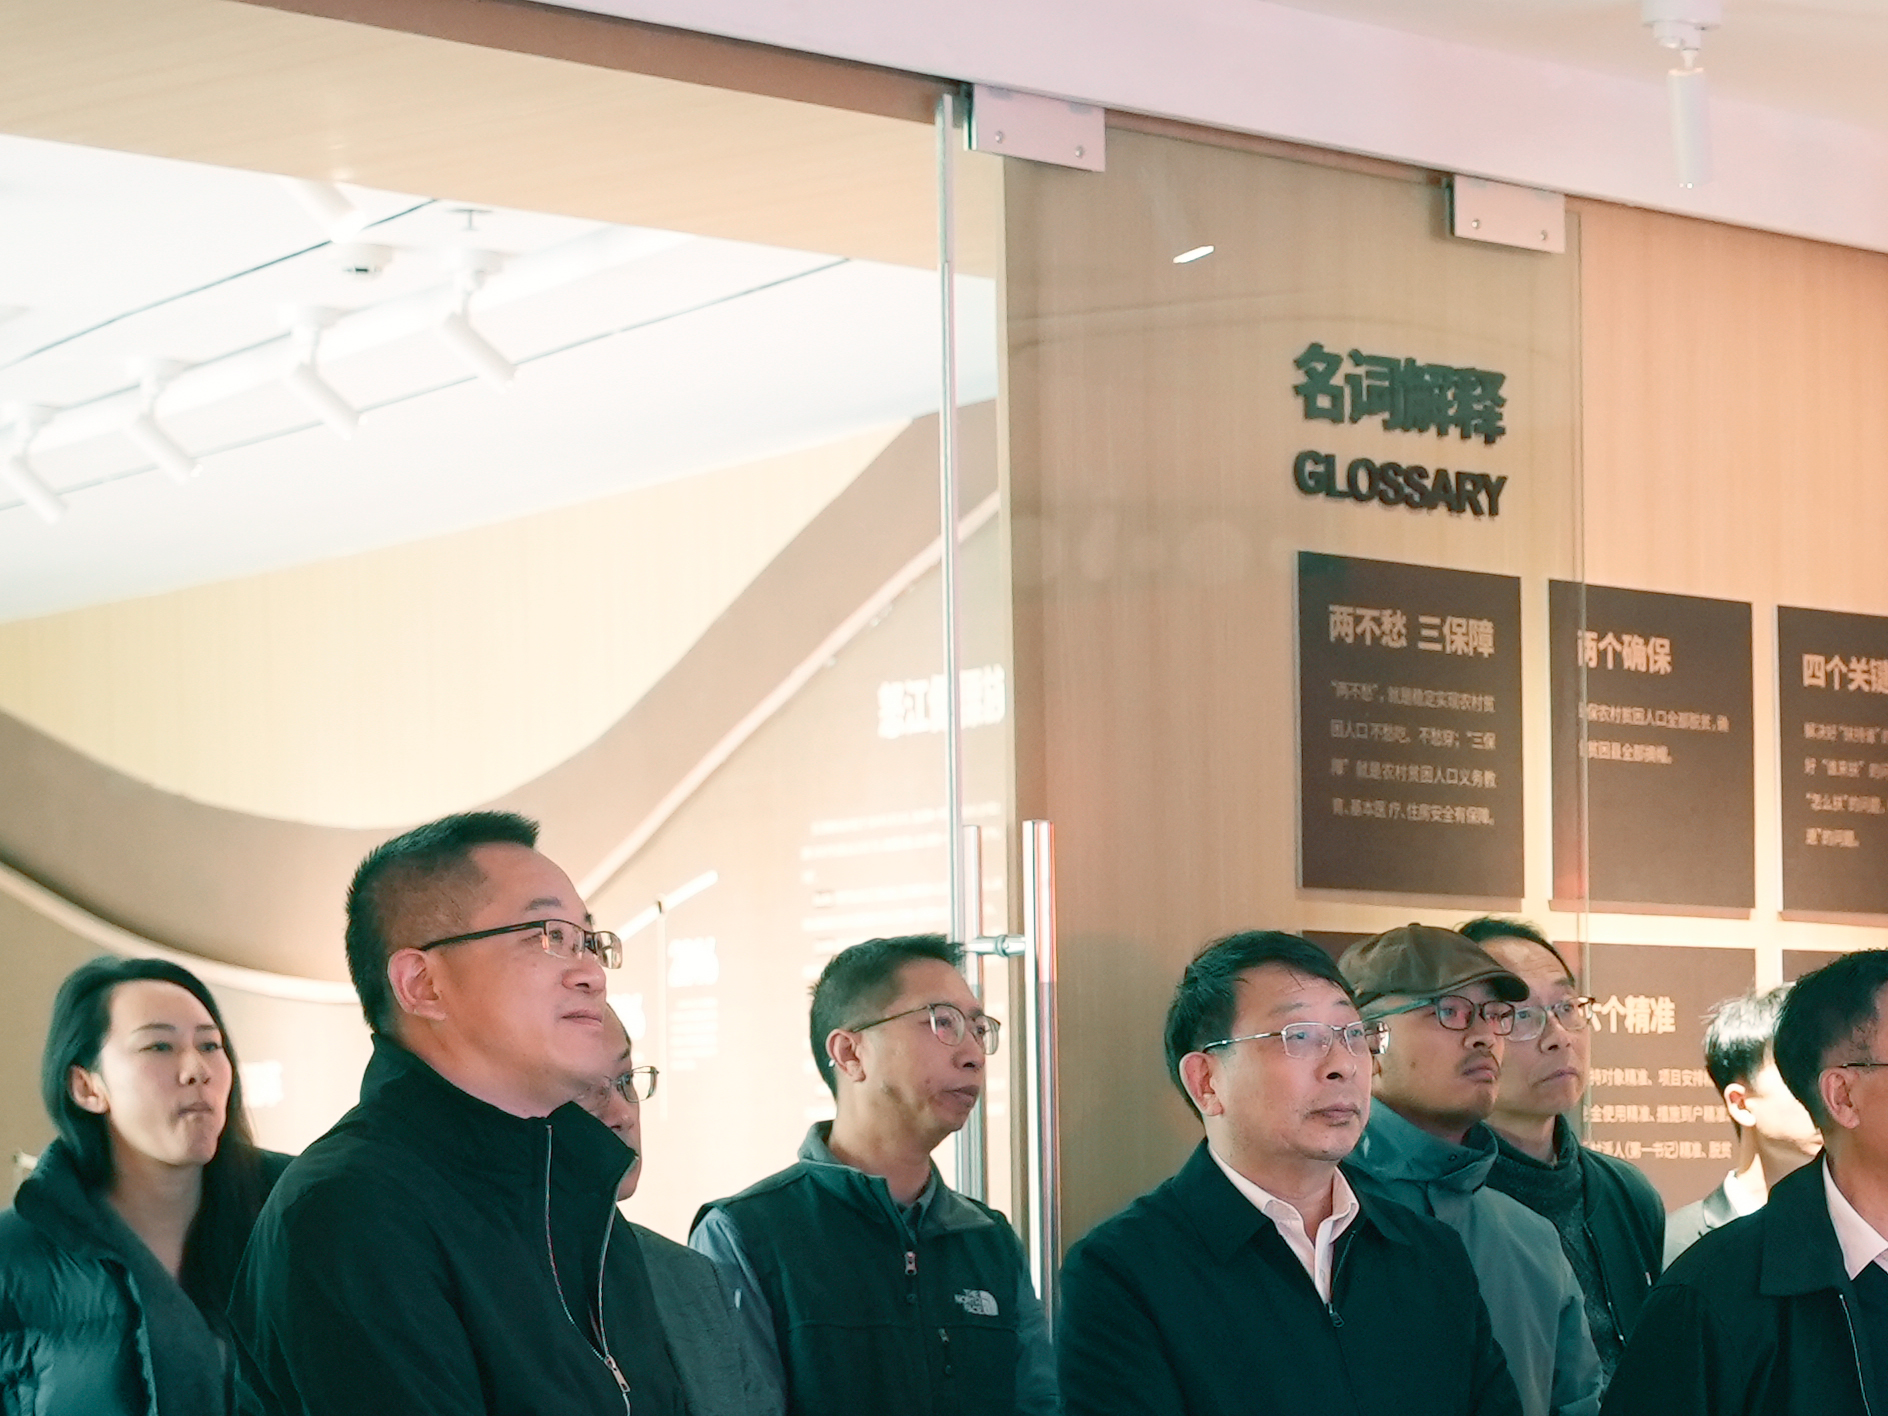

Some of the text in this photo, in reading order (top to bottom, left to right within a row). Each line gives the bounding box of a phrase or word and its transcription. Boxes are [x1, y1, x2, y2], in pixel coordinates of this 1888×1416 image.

[1293, 342, 1507, 444] 名词解释
[1294, 450, 1508, 517] GLOSSARY
[1328, 604, 1495, 659] 两不愁 三保障
[1577, 629, 1672, 675] 两个确保
